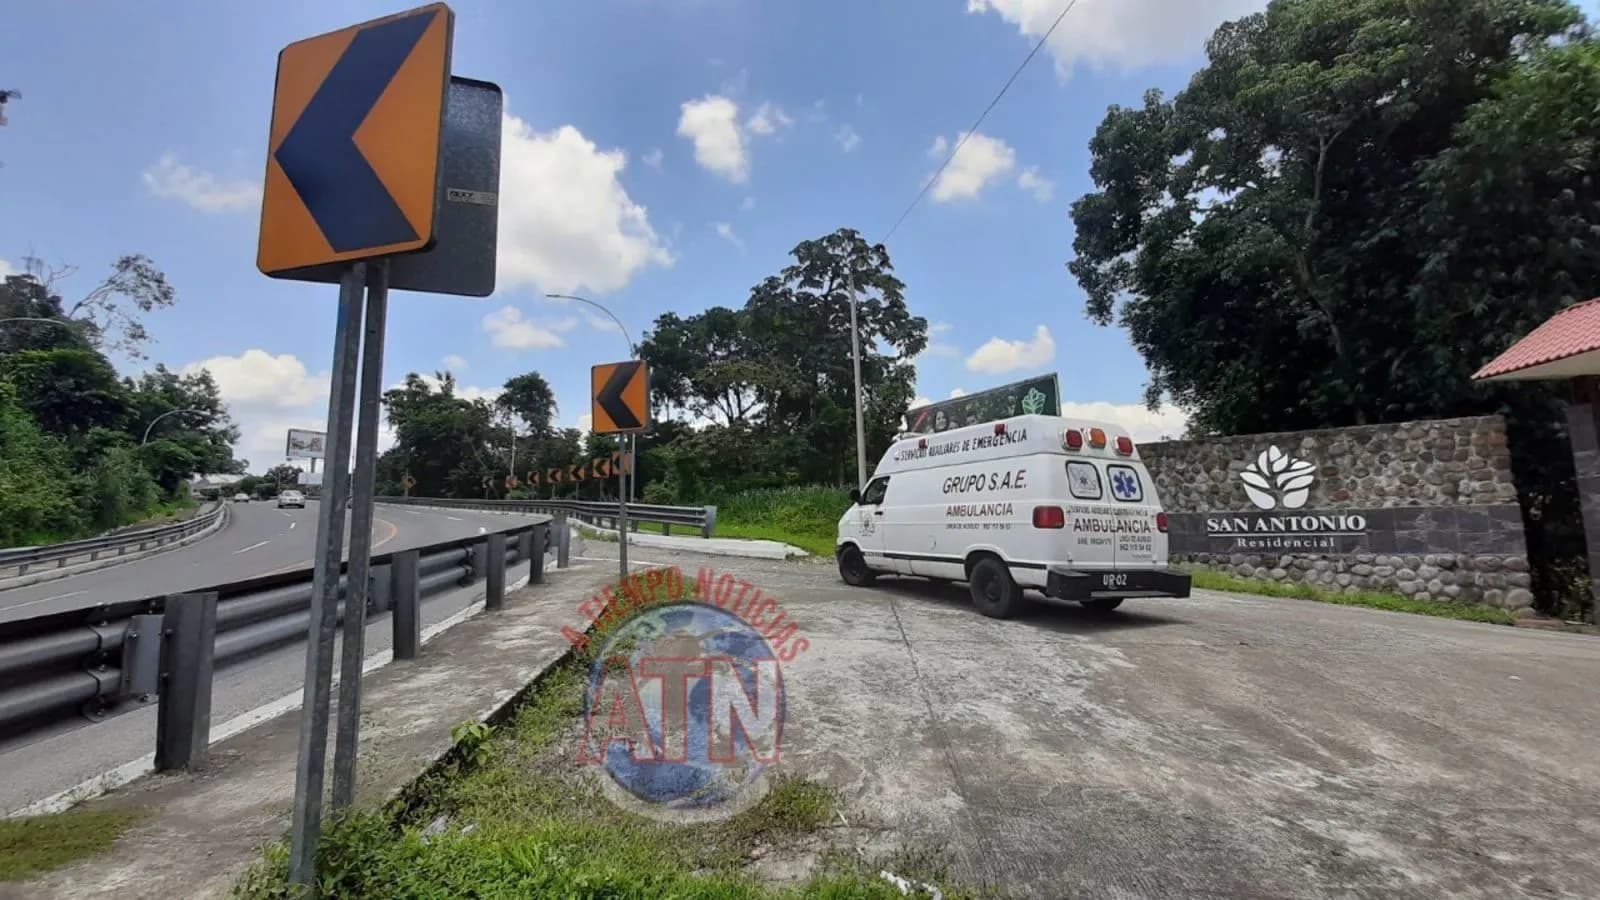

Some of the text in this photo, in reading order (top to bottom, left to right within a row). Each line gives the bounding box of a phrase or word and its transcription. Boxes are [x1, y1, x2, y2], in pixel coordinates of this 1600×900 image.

[972, 428, 1027, 451] EMERGENCIA
[943, 469, 1026, 494] GRUPO S.A.E.
[946, 502, 1013, 517] AMBULANCIA
[1073, 518, 1151, 534] AMBULANCIA
[1207, 515, 1366, 532] SAN ANTONIO
[1237, 537, 1335, 549] Residencial
